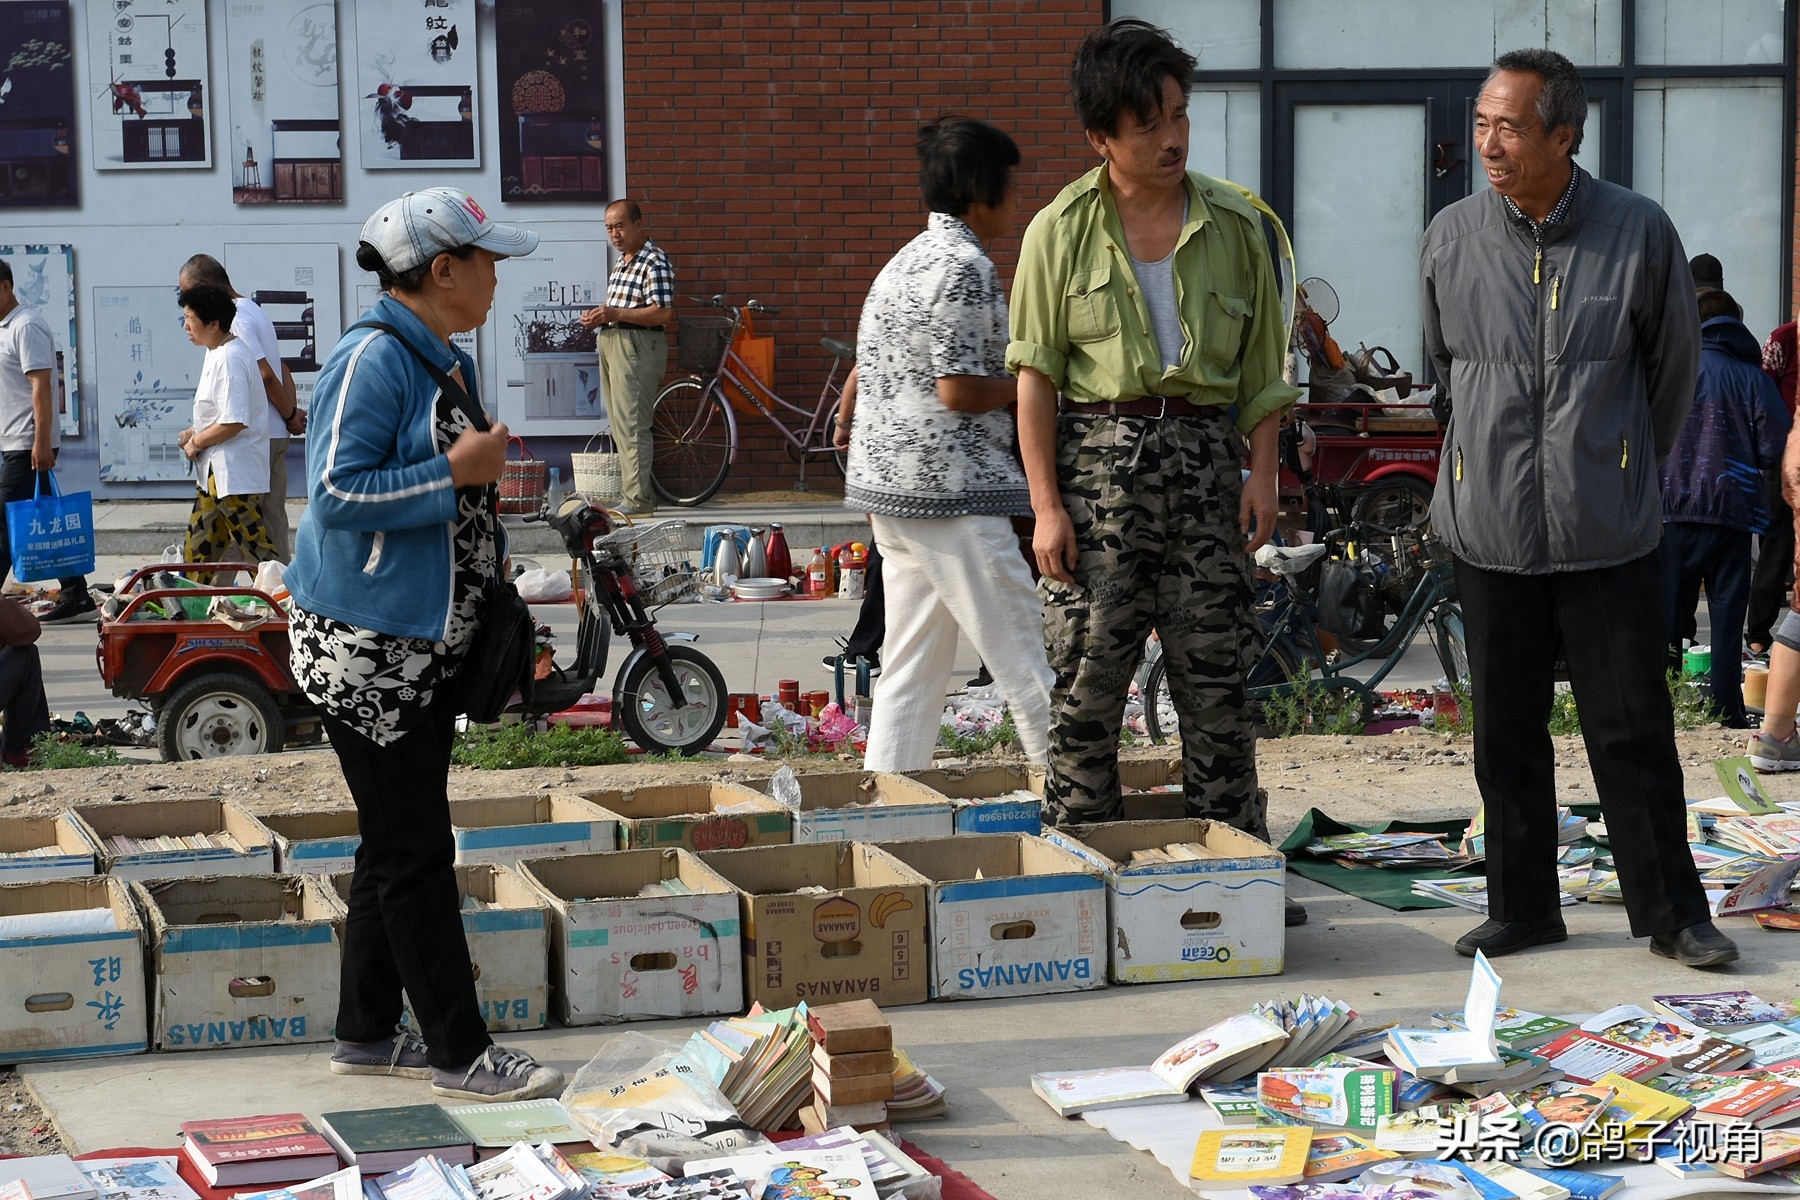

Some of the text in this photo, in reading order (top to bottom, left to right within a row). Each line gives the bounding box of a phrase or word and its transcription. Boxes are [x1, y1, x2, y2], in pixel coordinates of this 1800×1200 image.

[28, 512, 82, 536] 九龙园
[1012, 910, 1025, 919] AT
[1026, 908, 1050, 919] KEEP
[612, 921, 665, 937] delicious
[817, 920, 856, 933] BANANAS
[1181, 946, 1231, 963] Ocean
[958, 957, 1090, 990] BANANAS
[795, 976, 880, 998] BANANAS
[168, 1015, 307, 1046] BANANAS
